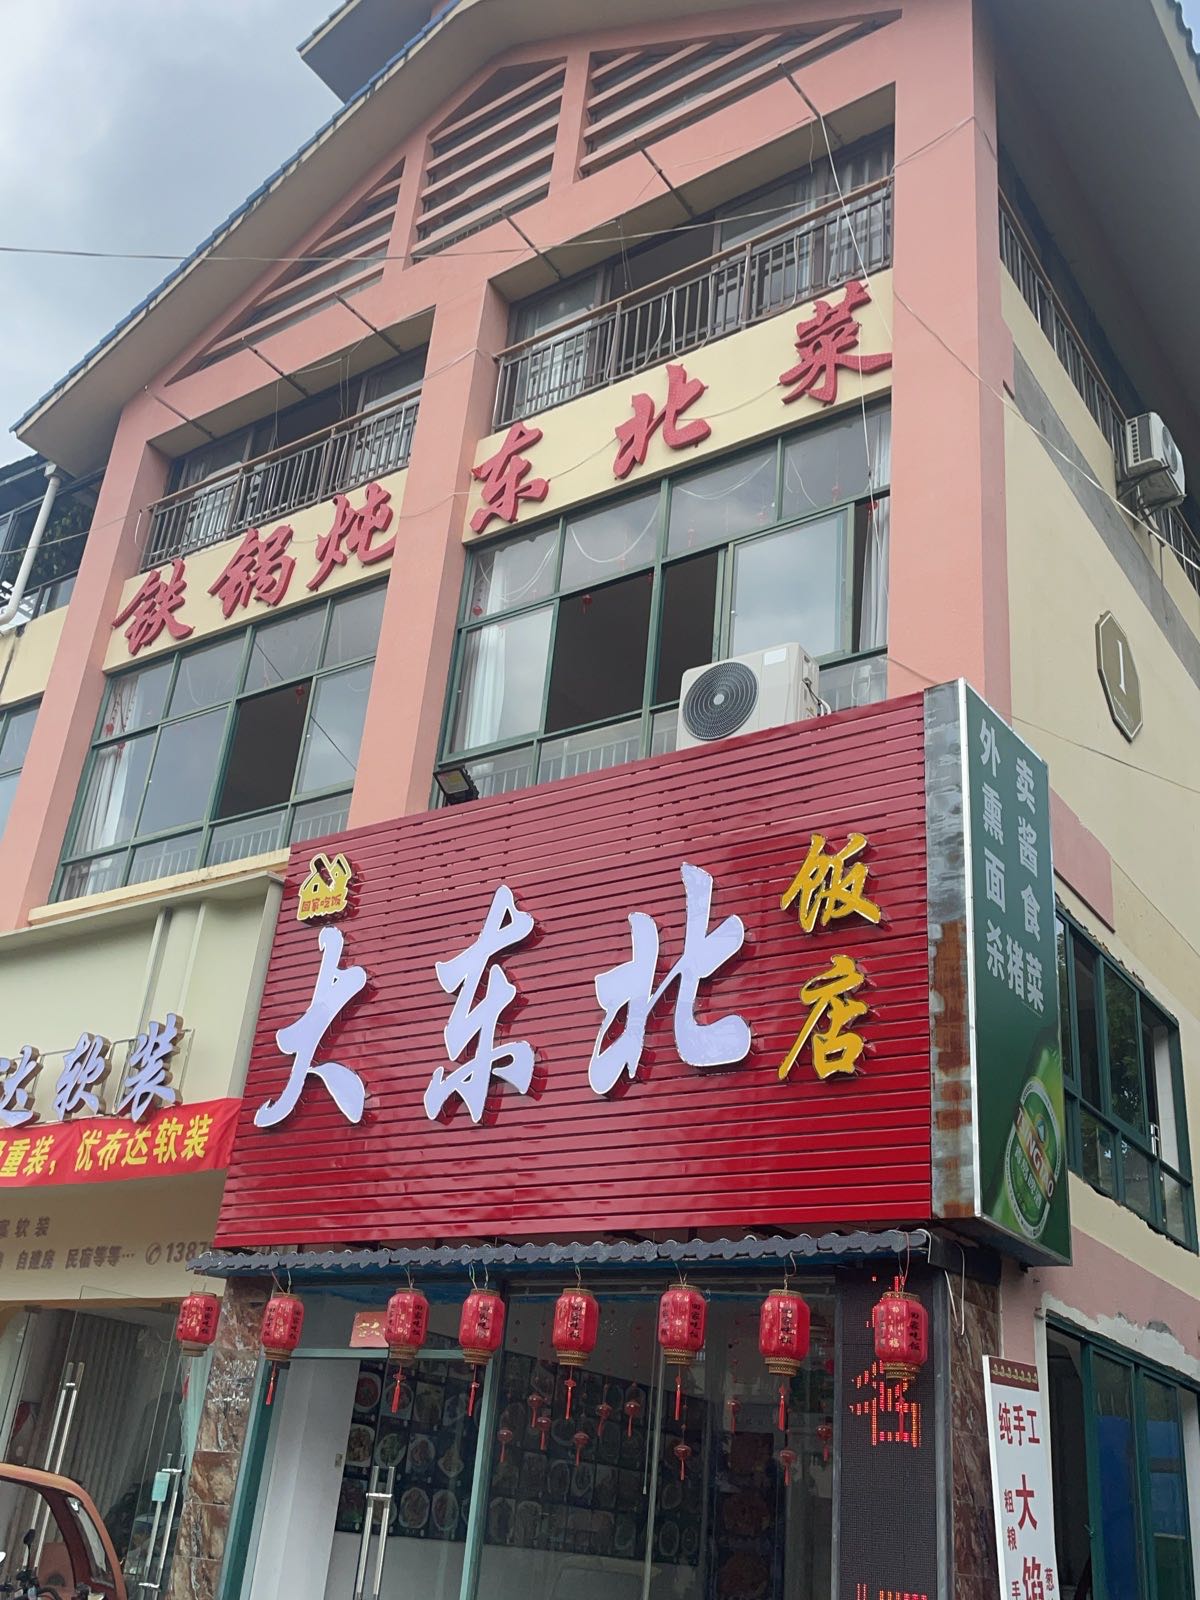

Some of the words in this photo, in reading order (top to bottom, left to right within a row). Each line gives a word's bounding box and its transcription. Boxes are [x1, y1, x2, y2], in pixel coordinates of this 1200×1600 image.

[470, 281, 892, 534] 东北菜
[112, 483, 396, 656] 铁锅炖
[253, 861, 752, 1128] 大东北
[780, 832, 882, 1081] 饭店
[985, 919, 1044, 1013] 杀猪菜
[999, 1402, 1040, 1446] 纯手工
